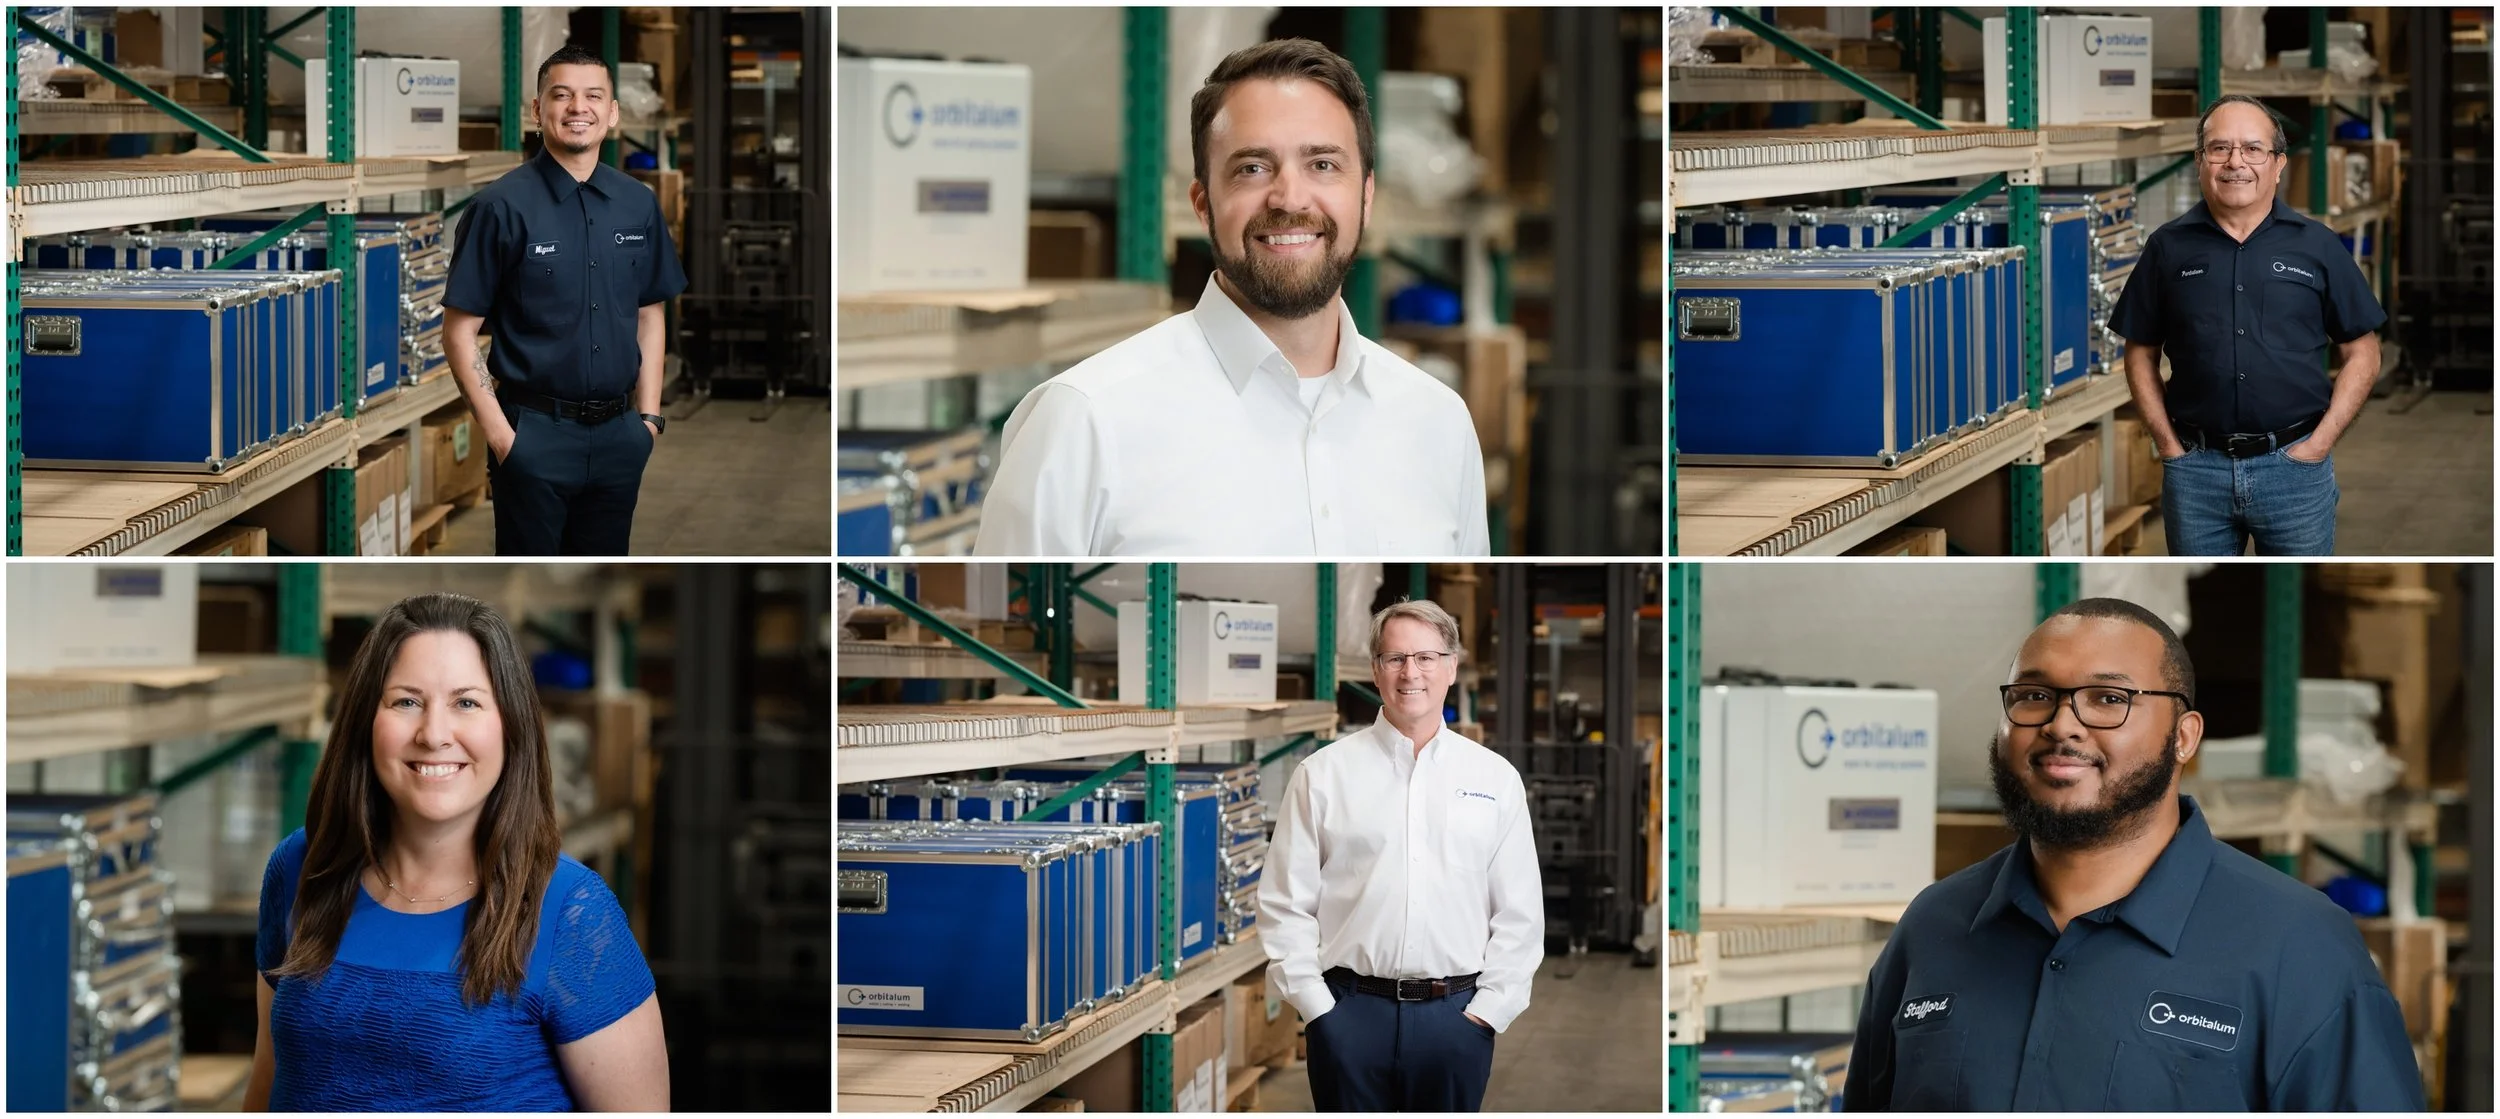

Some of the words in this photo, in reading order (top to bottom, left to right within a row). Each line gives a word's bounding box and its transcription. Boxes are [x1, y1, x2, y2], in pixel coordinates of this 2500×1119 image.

[2106, 33, 2147, 46] orbitalum
[535, 244, 556, 256] Miguel
[2287, 266, 2314, 278] orbitalum
[1842, 724, 1928, 748] orbitalum
[1469, 792, 1496, 801] orbitalum
[868, 992, 911, 1001] orbitalum
[1904, 997, 1949, 1020] Stafford
[2178, 1014, 2236, 1035] orbitalum
